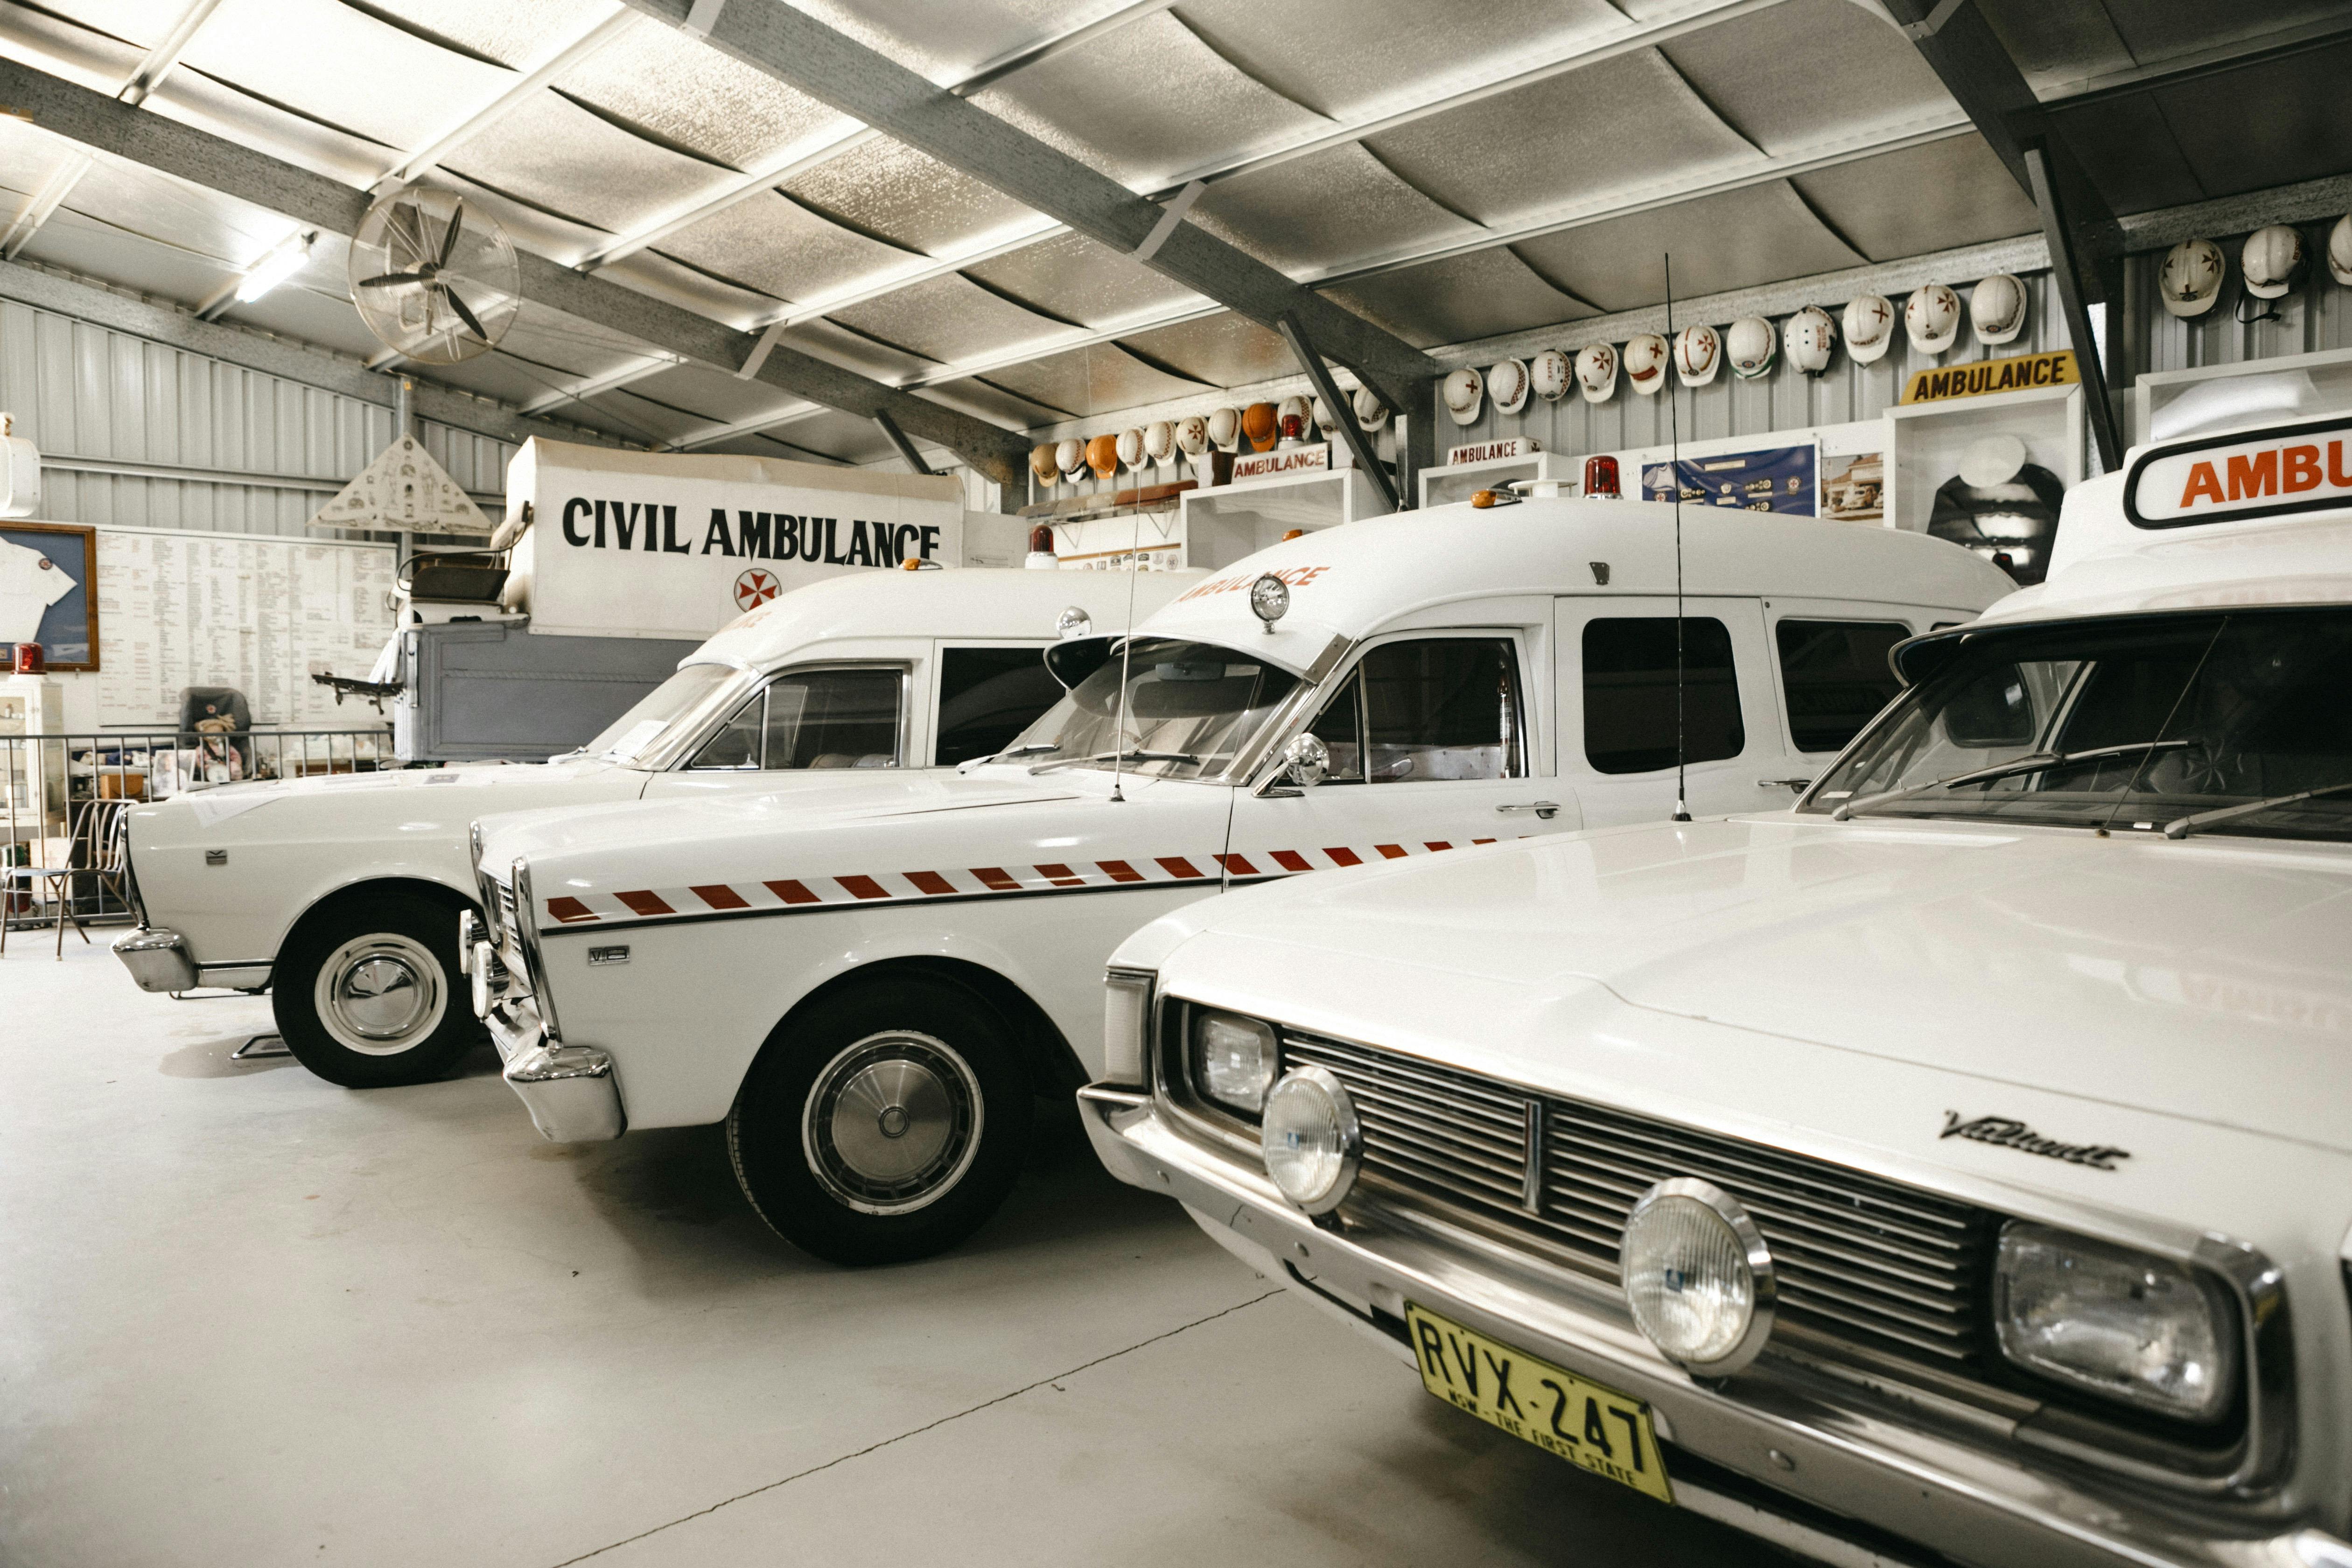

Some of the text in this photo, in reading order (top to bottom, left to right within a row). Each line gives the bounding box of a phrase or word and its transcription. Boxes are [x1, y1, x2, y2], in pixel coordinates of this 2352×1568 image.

[1914, 356, 2066, 400] AMBULANCE
[1234, 449, 1325, 478] AMBULANCE
[1452, 441, 1516, 465] AMBULANCE
[2181, 440, 2352, 507] AMBU
[563, 497, 941, 568] CIVIL AMBULANCE
[1449, 1389, 1478, 1414] NSW
[1495, 1412, 1523, 1437] THE
[1532, 1428, 1575, 1460] FIRST
[1585, 1453, 1637, 1486] STATE
